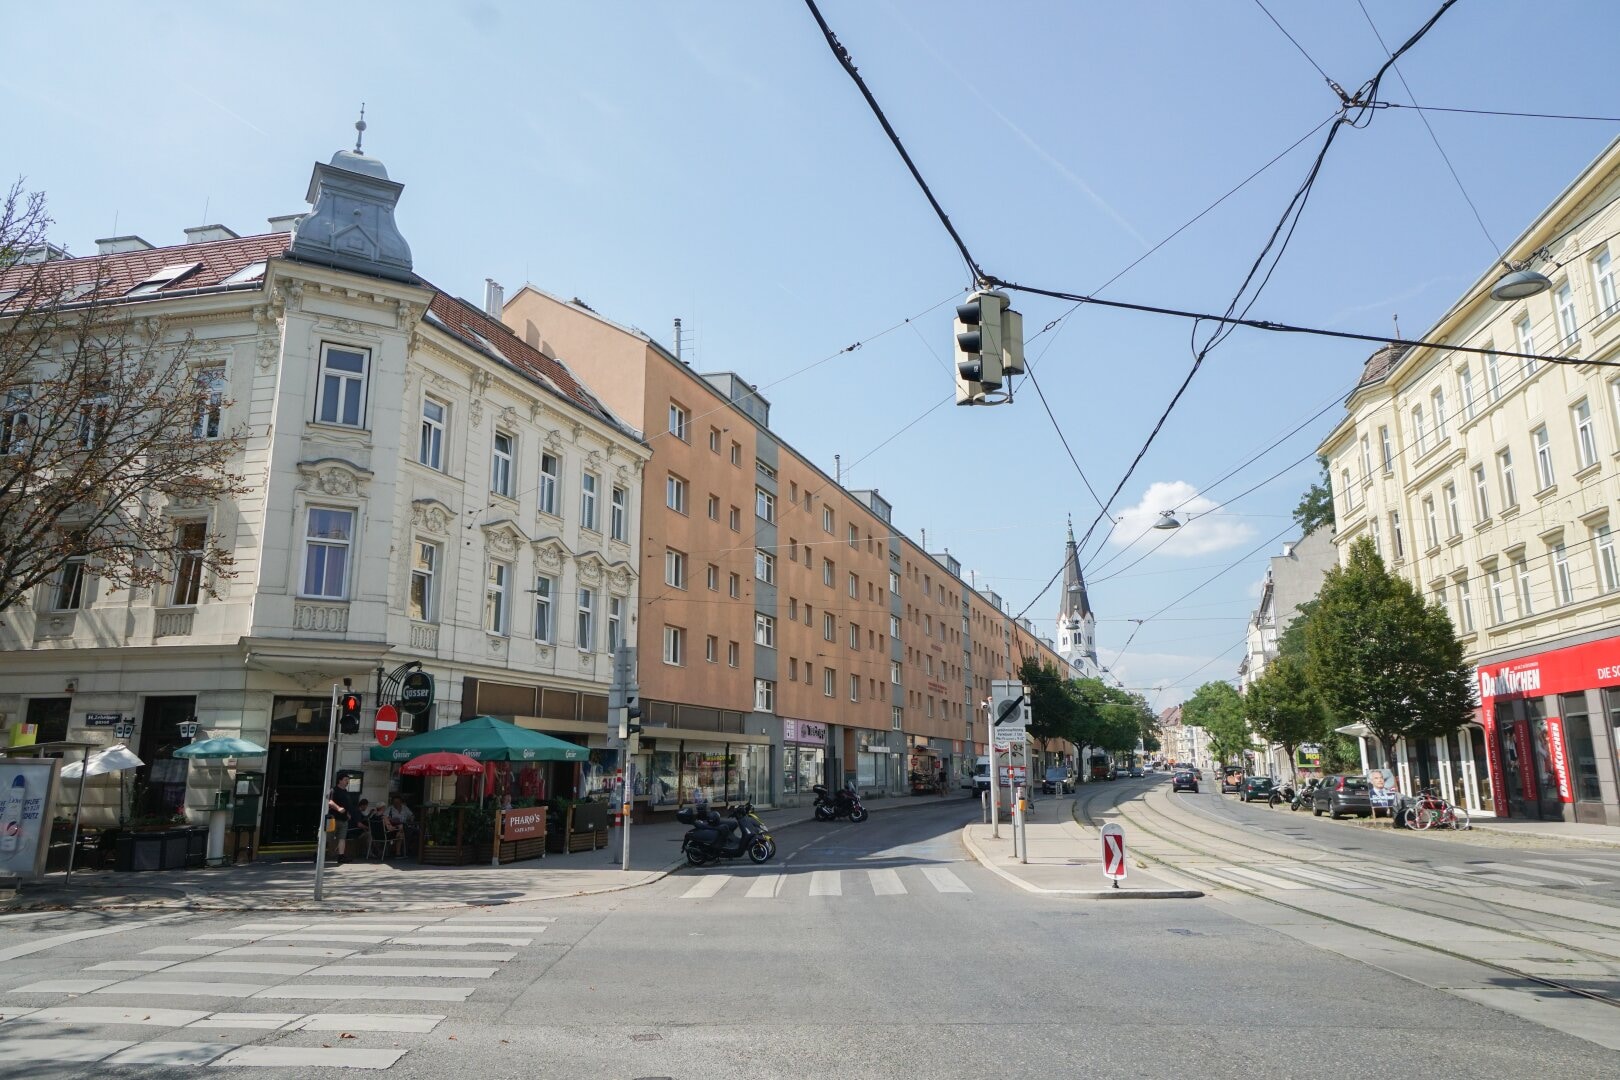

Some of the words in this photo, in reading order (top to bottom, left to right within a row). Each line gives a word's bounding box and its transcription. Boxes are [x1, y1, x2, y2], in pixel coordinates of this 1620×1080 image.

[1597, 667, 1611, 680] DIE
[402, 684, 430, 700] Gösser
[510, 813, 540, 827] PHARO'S
